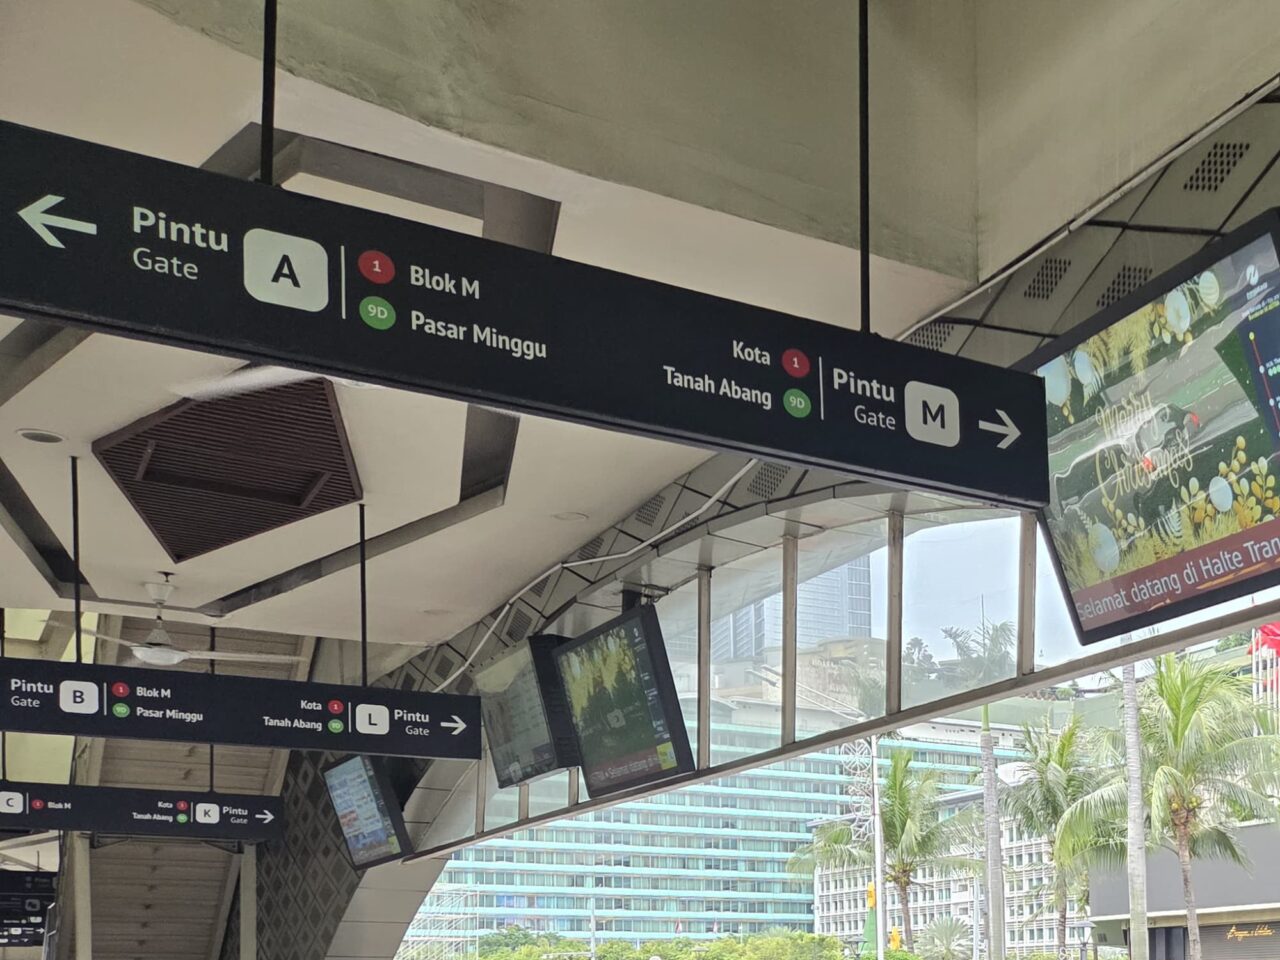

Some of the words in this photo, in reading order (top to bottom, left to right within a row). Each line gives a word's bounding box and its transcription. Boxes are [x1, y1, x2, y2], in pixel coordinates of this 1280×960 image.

[132, 206, 229, 253] Pintu
[132, 247, 199, 281] Gate
[270, 254, 301, 289] A
[371, 260, 382, 273] 1
[409, 264, 456, 296] Blok
[461, 273, 481, 300] M
[366, 302, 389, 320] 9D
[409, 310, 468, 343] Pasar
[472, 323, 548, 361] Minggu
[732, 340, 771, 367] Kota
[663, 365, 716, 395] Tanah
[719, 378, 773, 411] Abang
[832, 368, 896, 404] Pintu
[787, 394, 806, 410] 9D
[853, 405, 897, 431] Gate
[920, 402, 946, 430] M
[1076, 588, 1128, 621] Selamat
[1131, 572, 1182, 604] datang
[1184, 562, 1199, 585] di
[1200, 548, 1244, 580] Halte
[10, 678, 54, 694] Pintu
[136, 686, 159, 698] Blok
[161, 688, 171, 698] M
[10, 695, 41, 708] Gate
[72, 690, 85, 704] B
[300, 700, 322, 711] Kota
[136, 706, 163, 719] Pasar
[166, 708, 204, 723] Minggu
[368, 713, 378, 726] L
[394, 709, 429, 723] Pintu
[263, 716, 291, 728] Tanah
[293, 718, 322, 732] Abang
[405, 726, 430, 736] Gate
[222, 806, 248, 816] Pintu
